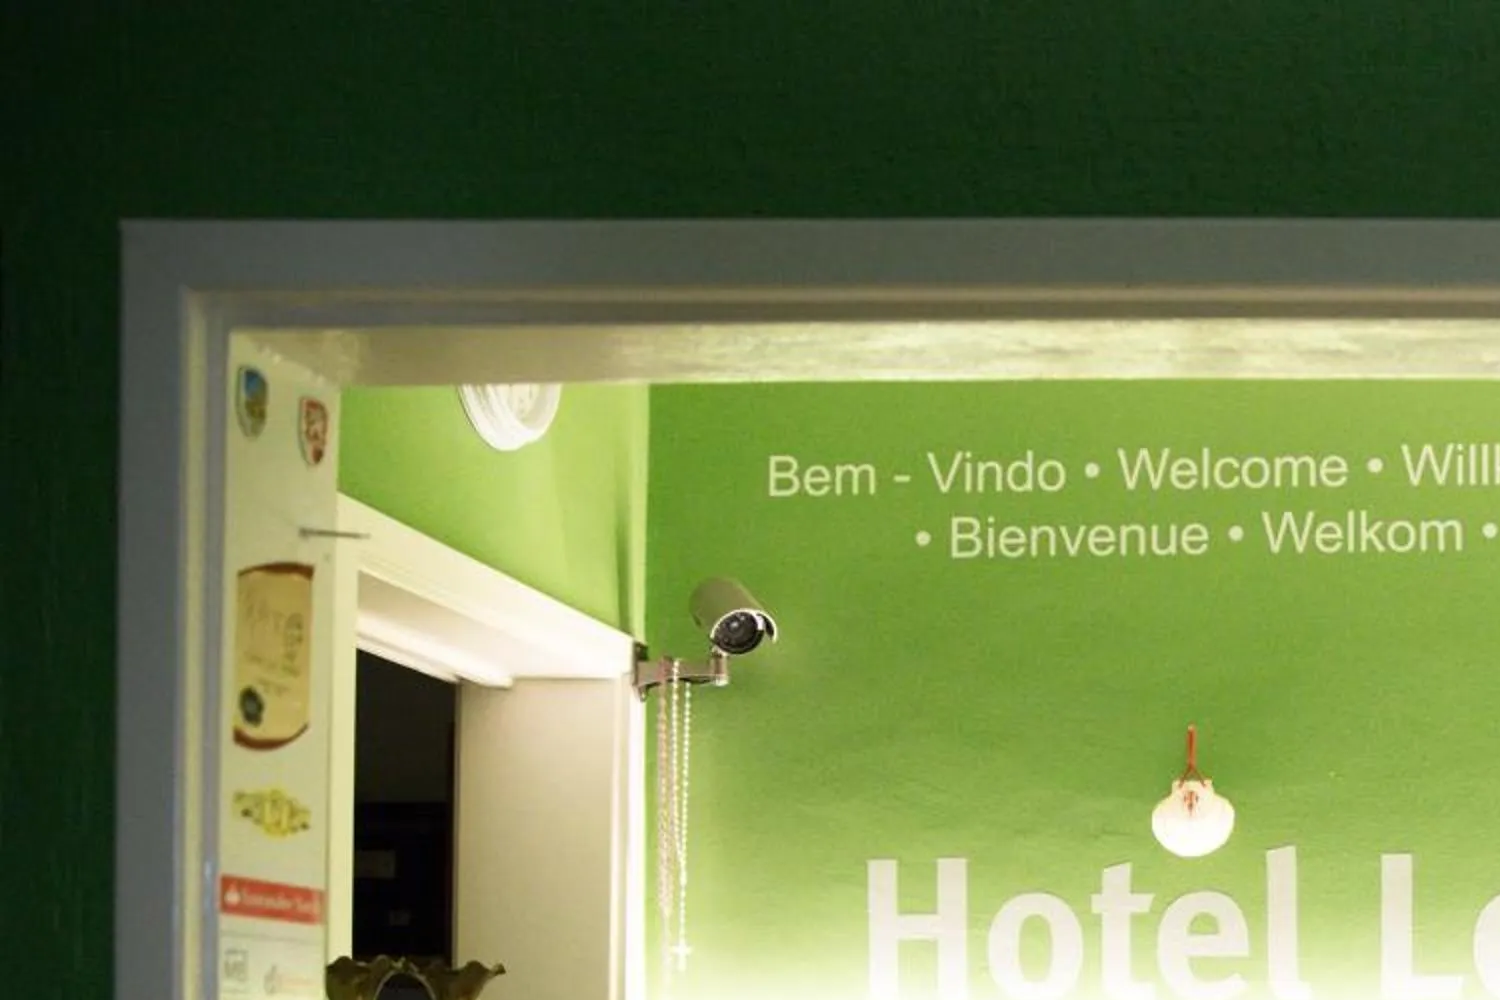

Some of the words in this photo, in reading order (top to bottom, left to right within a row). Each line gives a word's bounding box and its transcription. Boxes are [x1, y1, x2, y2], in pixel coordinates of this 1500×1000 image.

[768, 454, 876, 497] Bem
[926, 449, 1067, 493] Vindo
[1117, 446, 1349, 491] Welcome
[950, 514, 1210, 559] Bienvenue
[1261, 509, 1464, 554] Welkom
